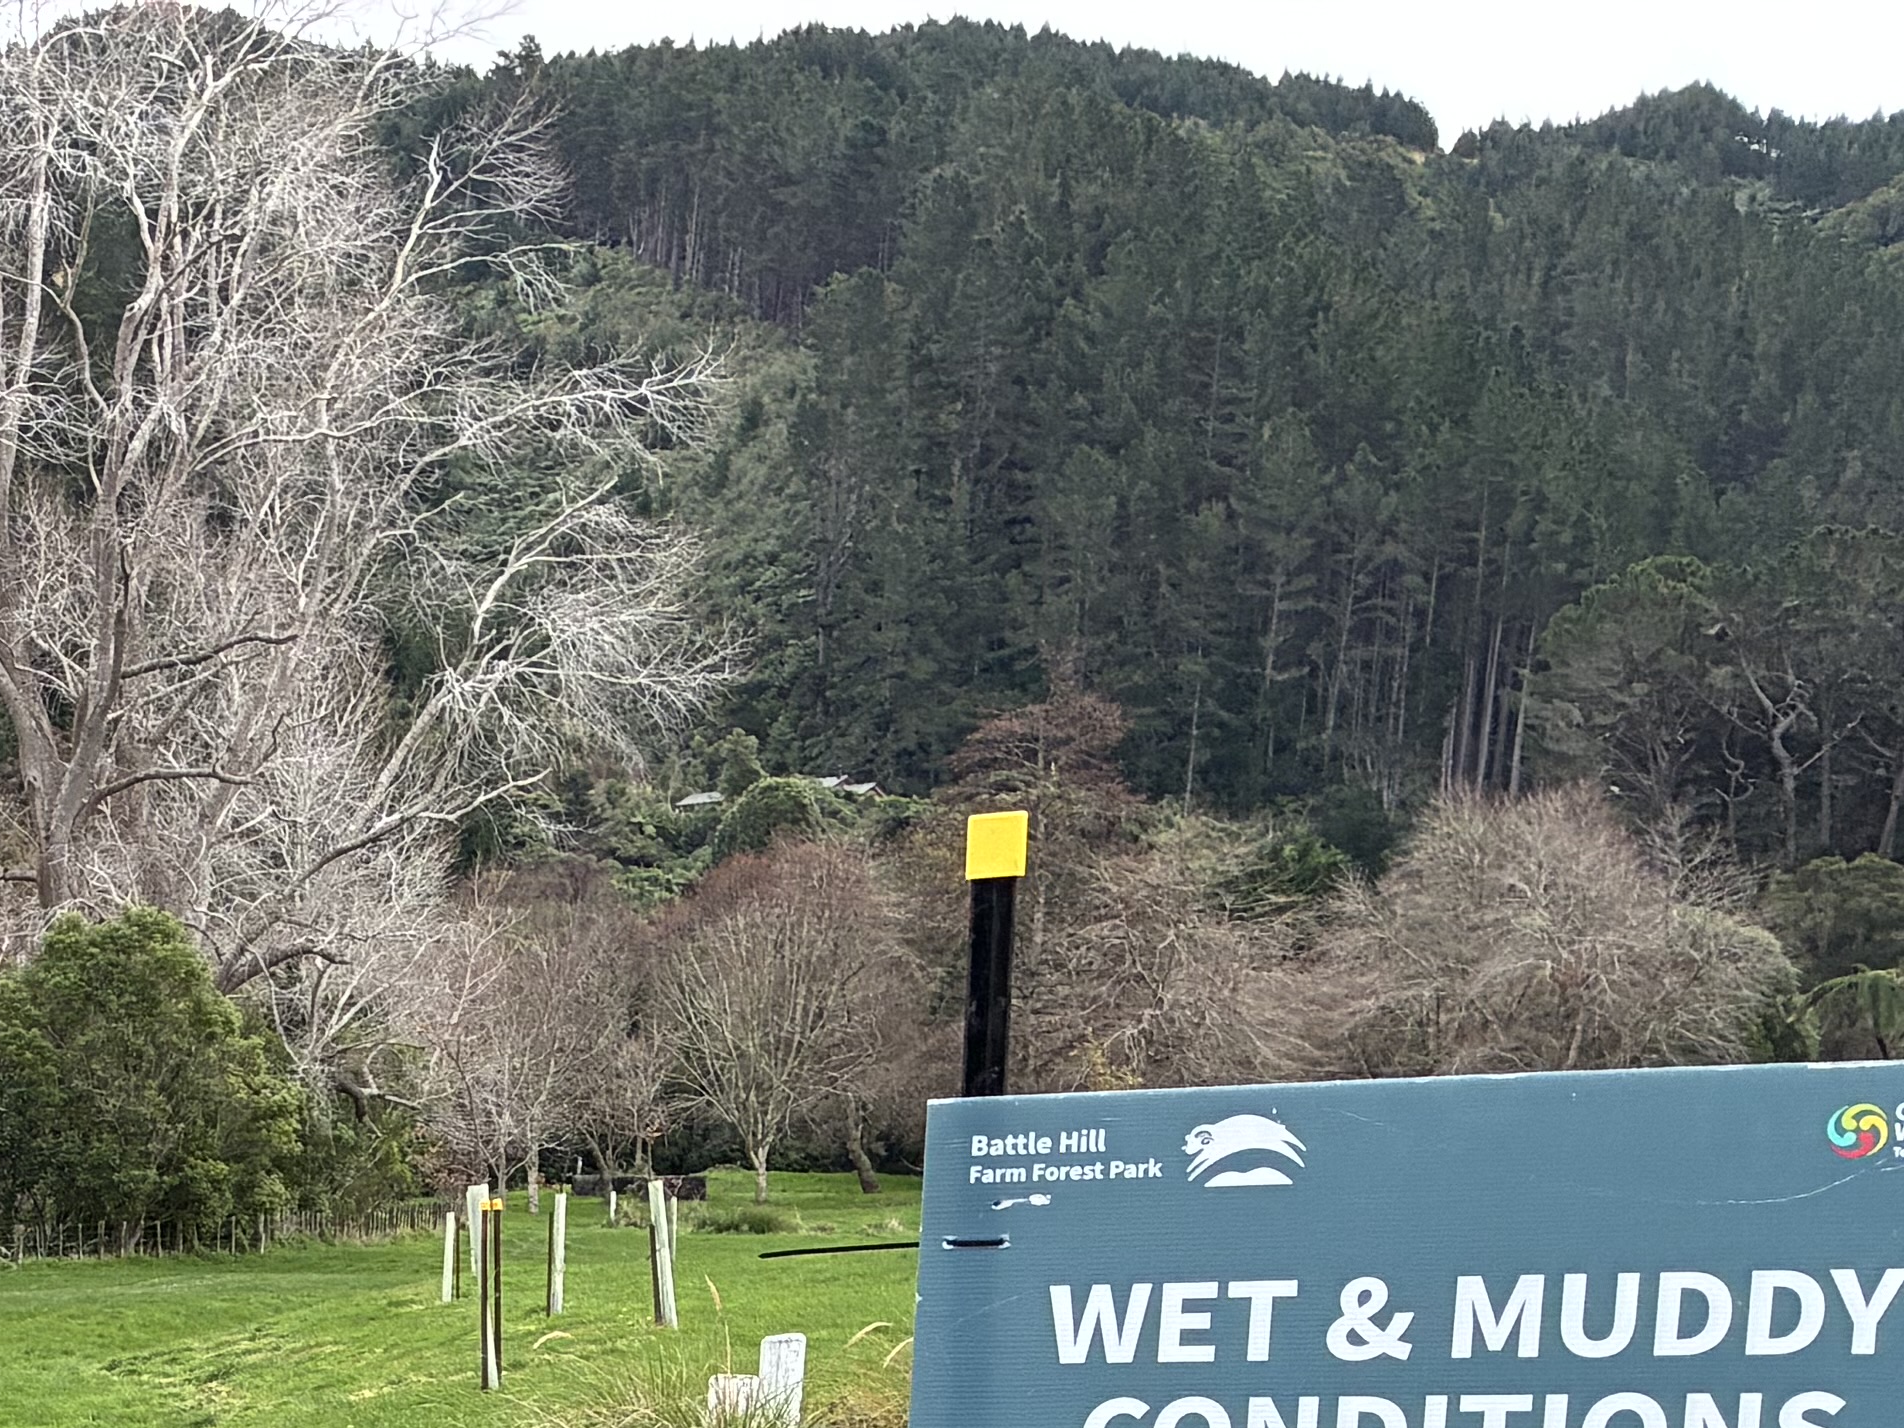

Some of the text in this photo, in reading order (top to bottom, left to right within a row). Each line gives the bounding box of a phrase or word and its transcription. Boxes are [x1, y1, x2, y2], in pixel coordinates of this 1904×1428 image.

[971, 1128, 1106, 1157] Battle Hill
[969, 1157, 1163, 1184] Farm Forest Park
[1049, 1268, 1904, 1365] WET & MUDDY
